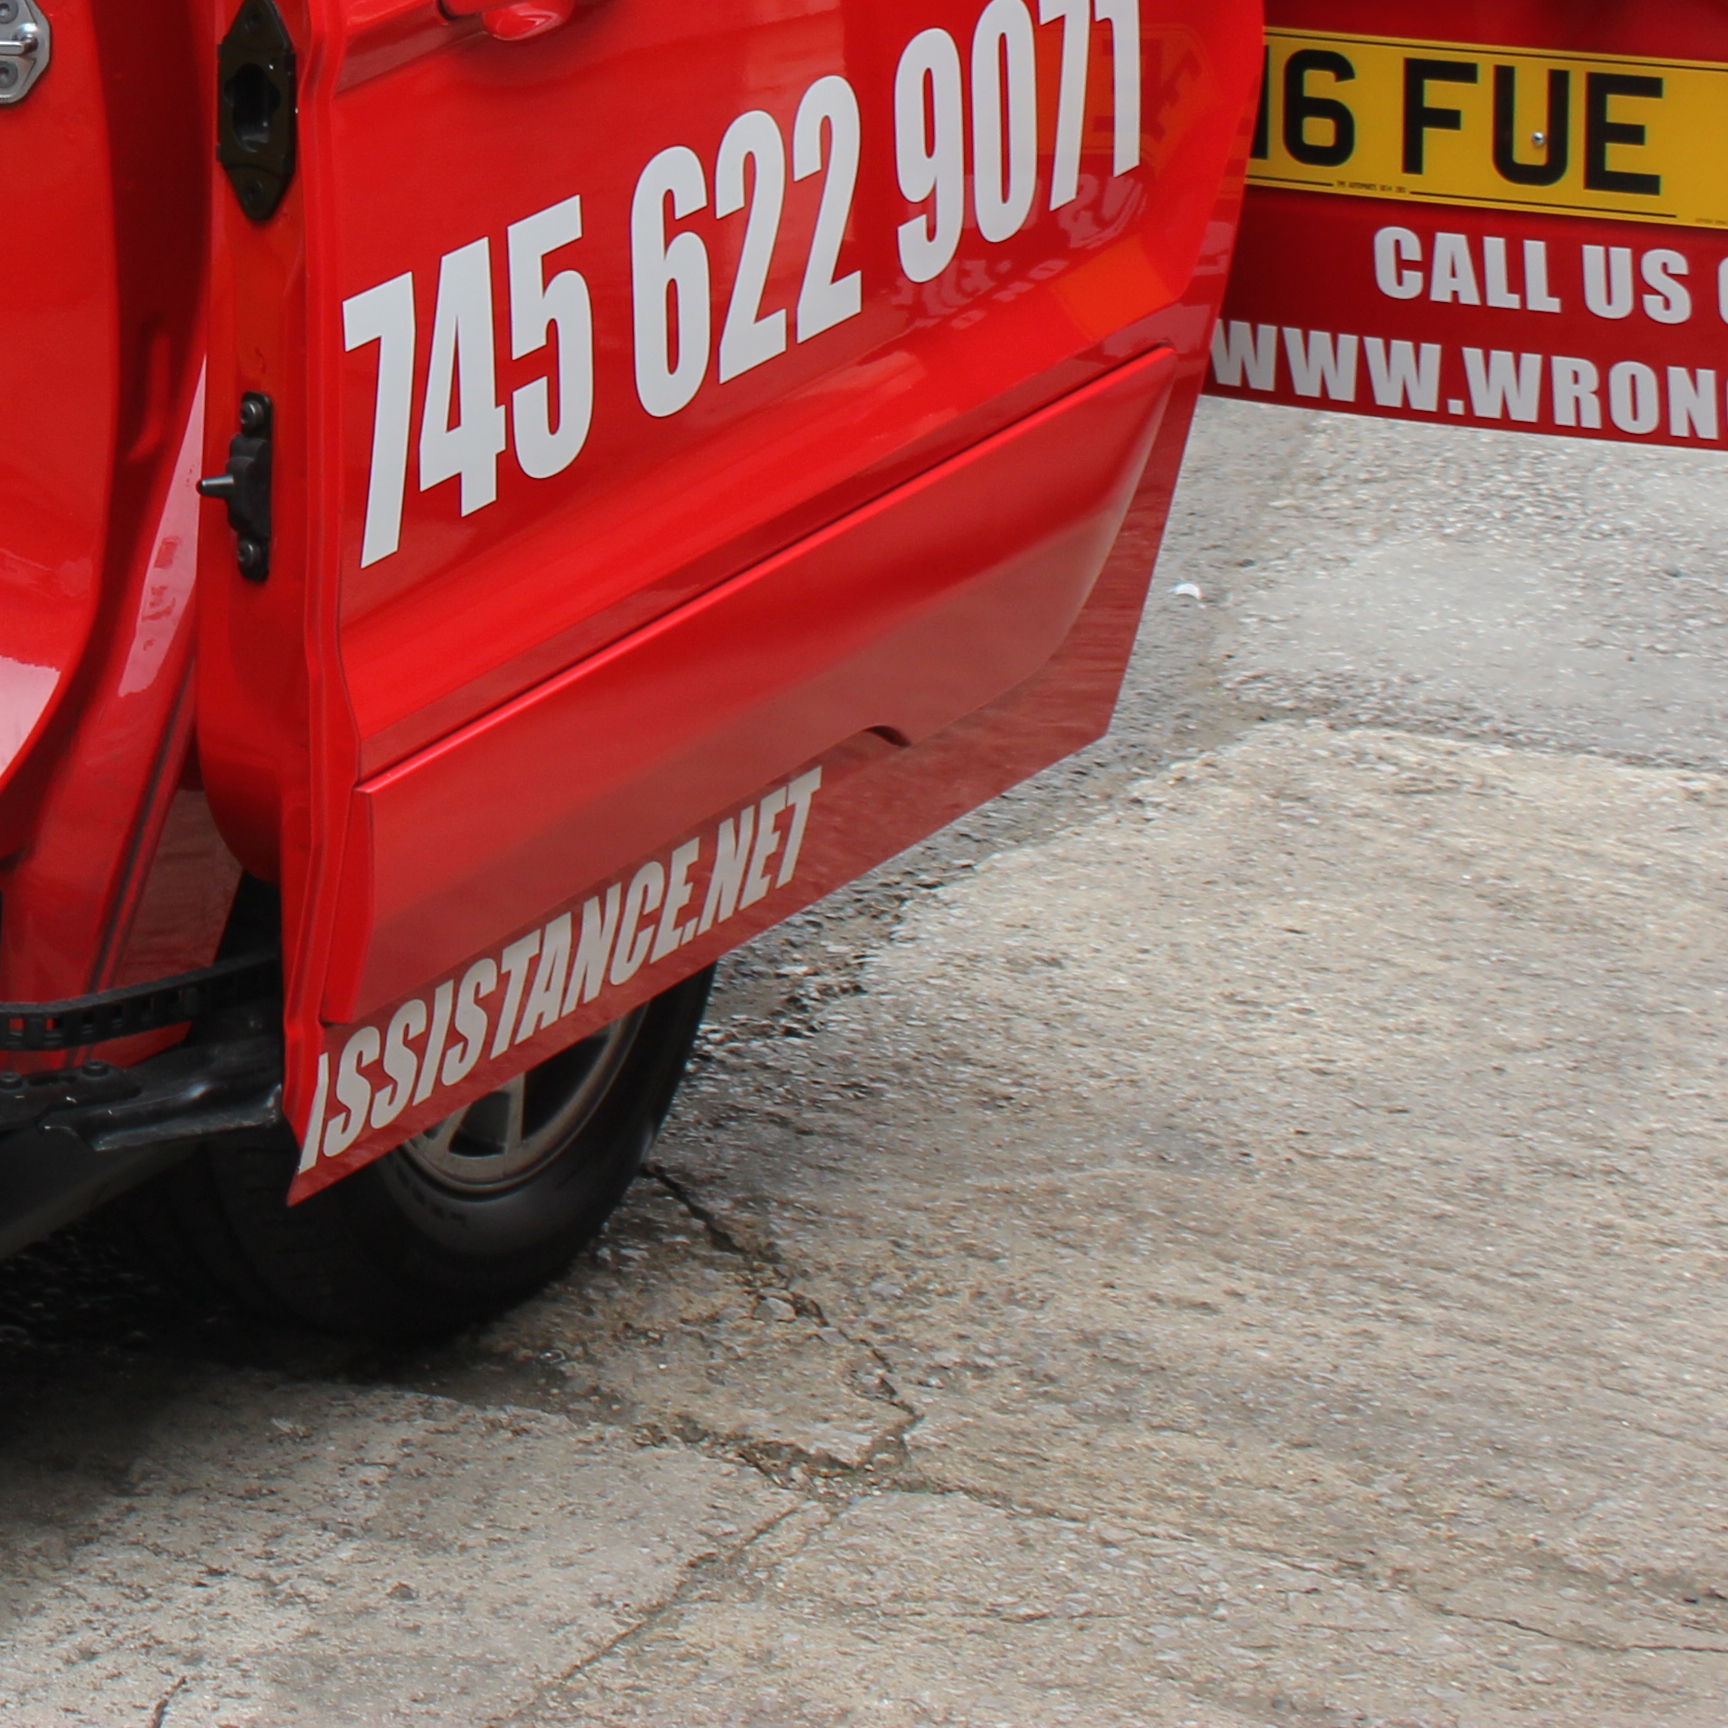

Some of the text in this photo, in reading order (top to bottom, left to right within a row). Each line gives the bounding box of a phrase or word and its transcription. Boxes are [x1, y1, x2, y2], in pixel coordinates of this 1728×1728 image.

[1401, 57, 1664, 197] FUE
[342, 195, 593, 568] 745
[631, 76, 862, 418] 622
[1373, 226, 1561, 313] CALL
[1582, 244, 1692, 325] US
[1210, 319, 1728, 440] WWW.WRON
